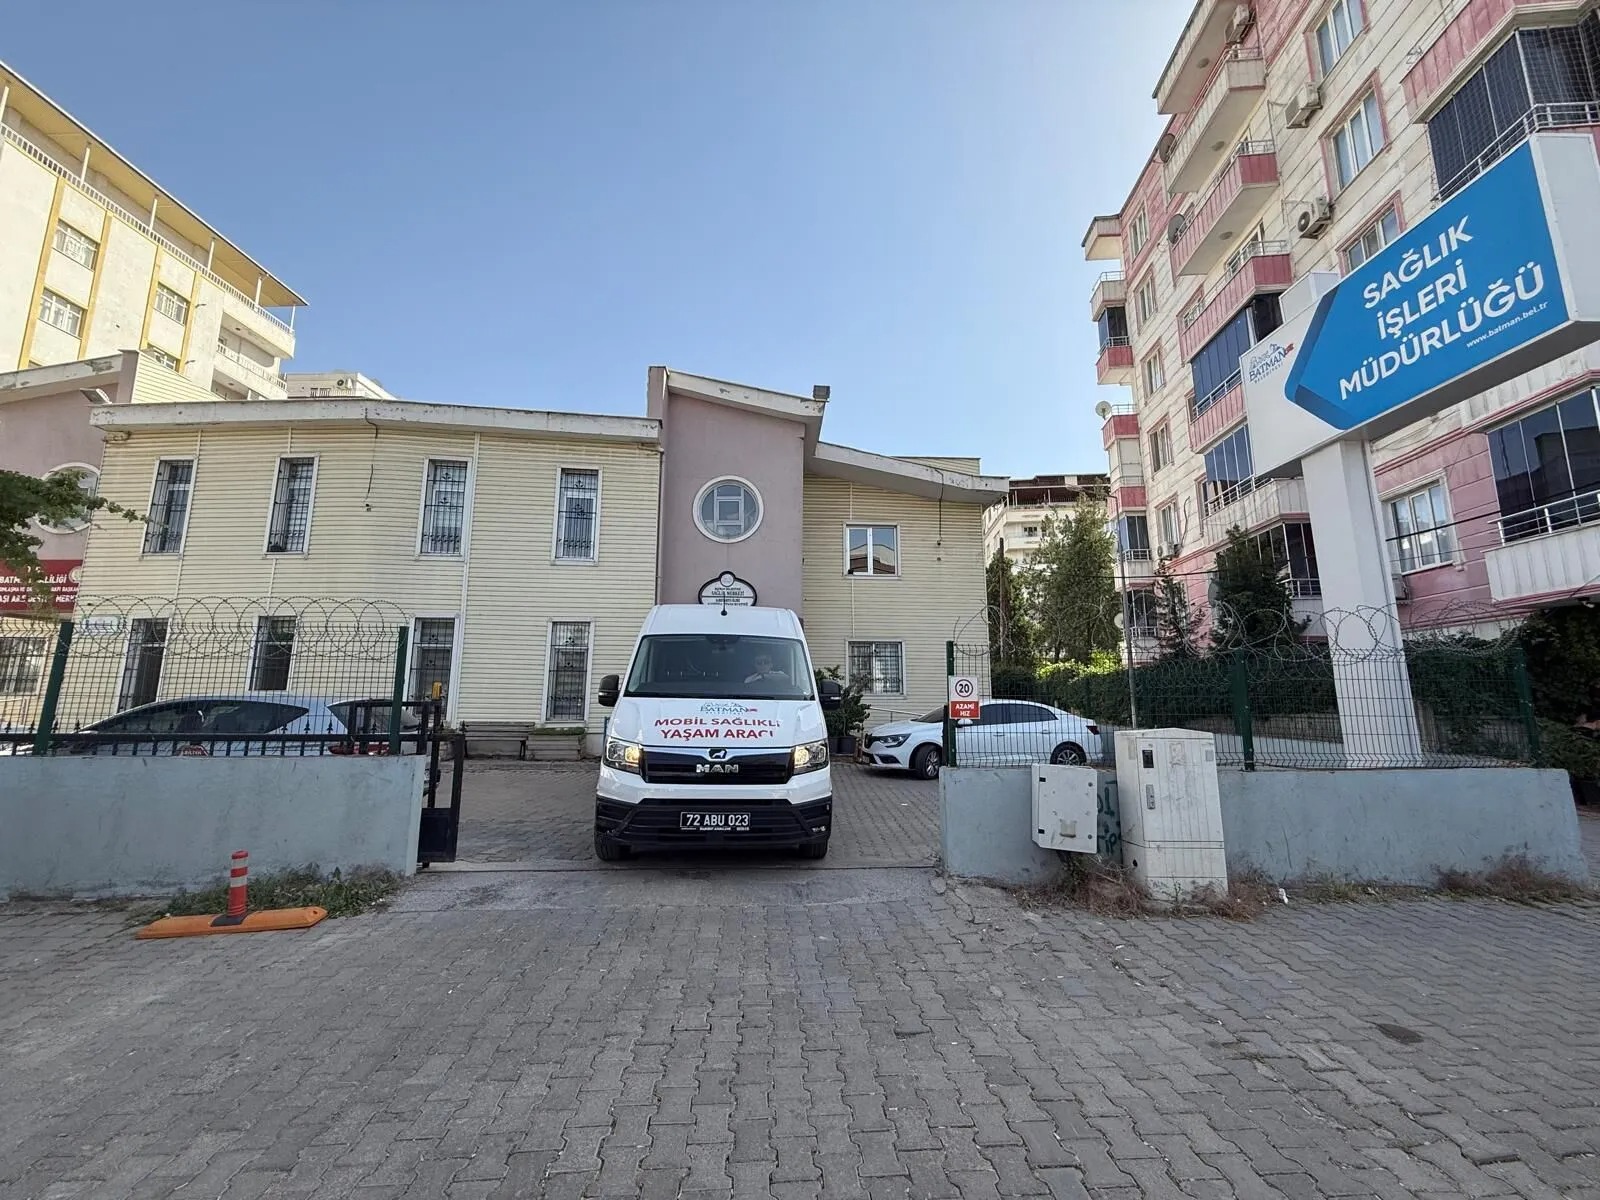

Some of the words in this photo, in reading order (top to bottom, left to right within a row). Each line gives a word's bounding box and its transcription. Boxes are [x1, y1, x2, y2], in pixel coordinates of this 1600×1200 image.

[1363, 215, 1474, 310] SAĞLIK
[1377, 258, 1468, 340] İŞLERİ
[1339, 261, 1545, 401] MÜDÜRLÜĞÜ
[1466, 301, 1549, 348] www.batman.bel.tr
[1249, 347, 1287, 382] BATMAN
[958, 683, 970, 693] 20
[654, 716, 707, 727] MOBİL
[660, 729, 719, 741] YAŞAM
[696, 764, 739, 773] MAN
[686, 814, 700, 826] 72
[703, 814, 725, 826] ABU
[728, 814, 749, 826] 023
